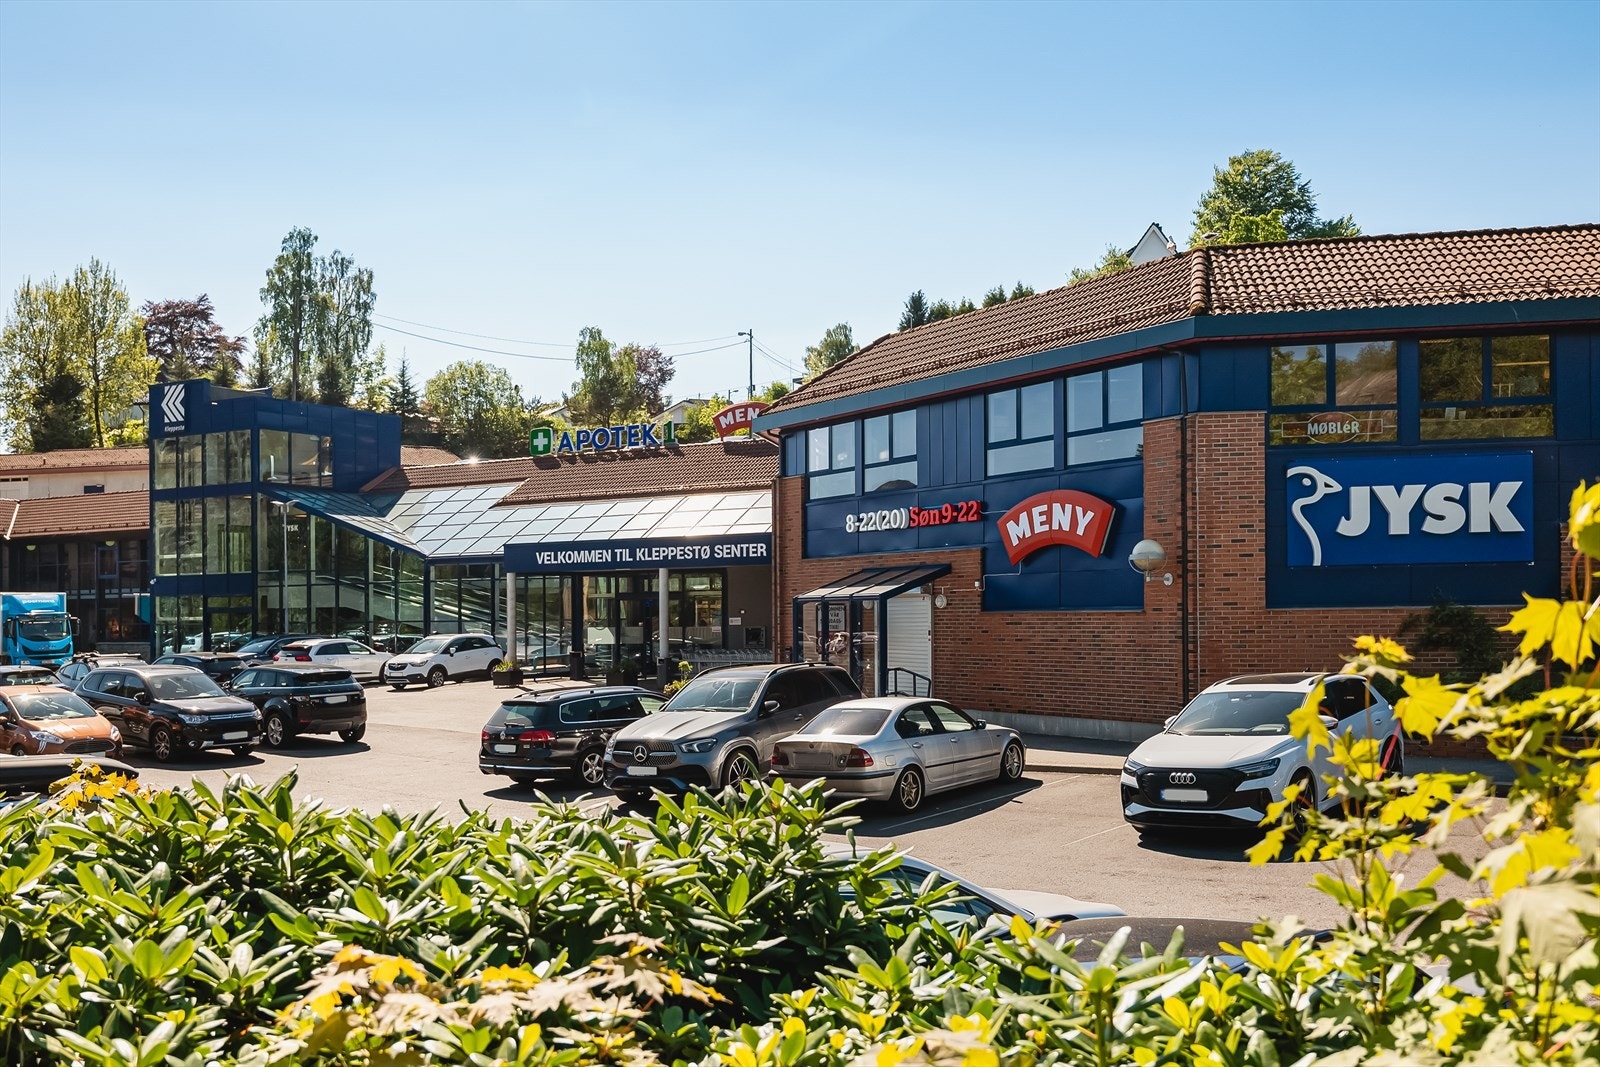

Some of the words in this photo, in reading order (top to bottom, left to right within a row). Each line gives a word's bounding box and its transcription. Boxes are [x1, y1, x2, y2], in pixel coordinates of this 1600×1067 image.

[718, 407, 761, 429] MEN
[557, 423, 660, 453] APOTEK
[663, 420, 677, 446] 1
[909, 506, 940, 527] Søn
[941, 500, 980, 524] 9-22
[1335, 481, 1526, 537] JYSK
[1005, 502, 1096, 547] MENY
[535, 549, 612, 565] VELKOMMEN
[615, 548, 633, 562] TIL
[636, 545, 711, 561] KLEPPESTØ
[714, 543, 767, 559] SENTER
